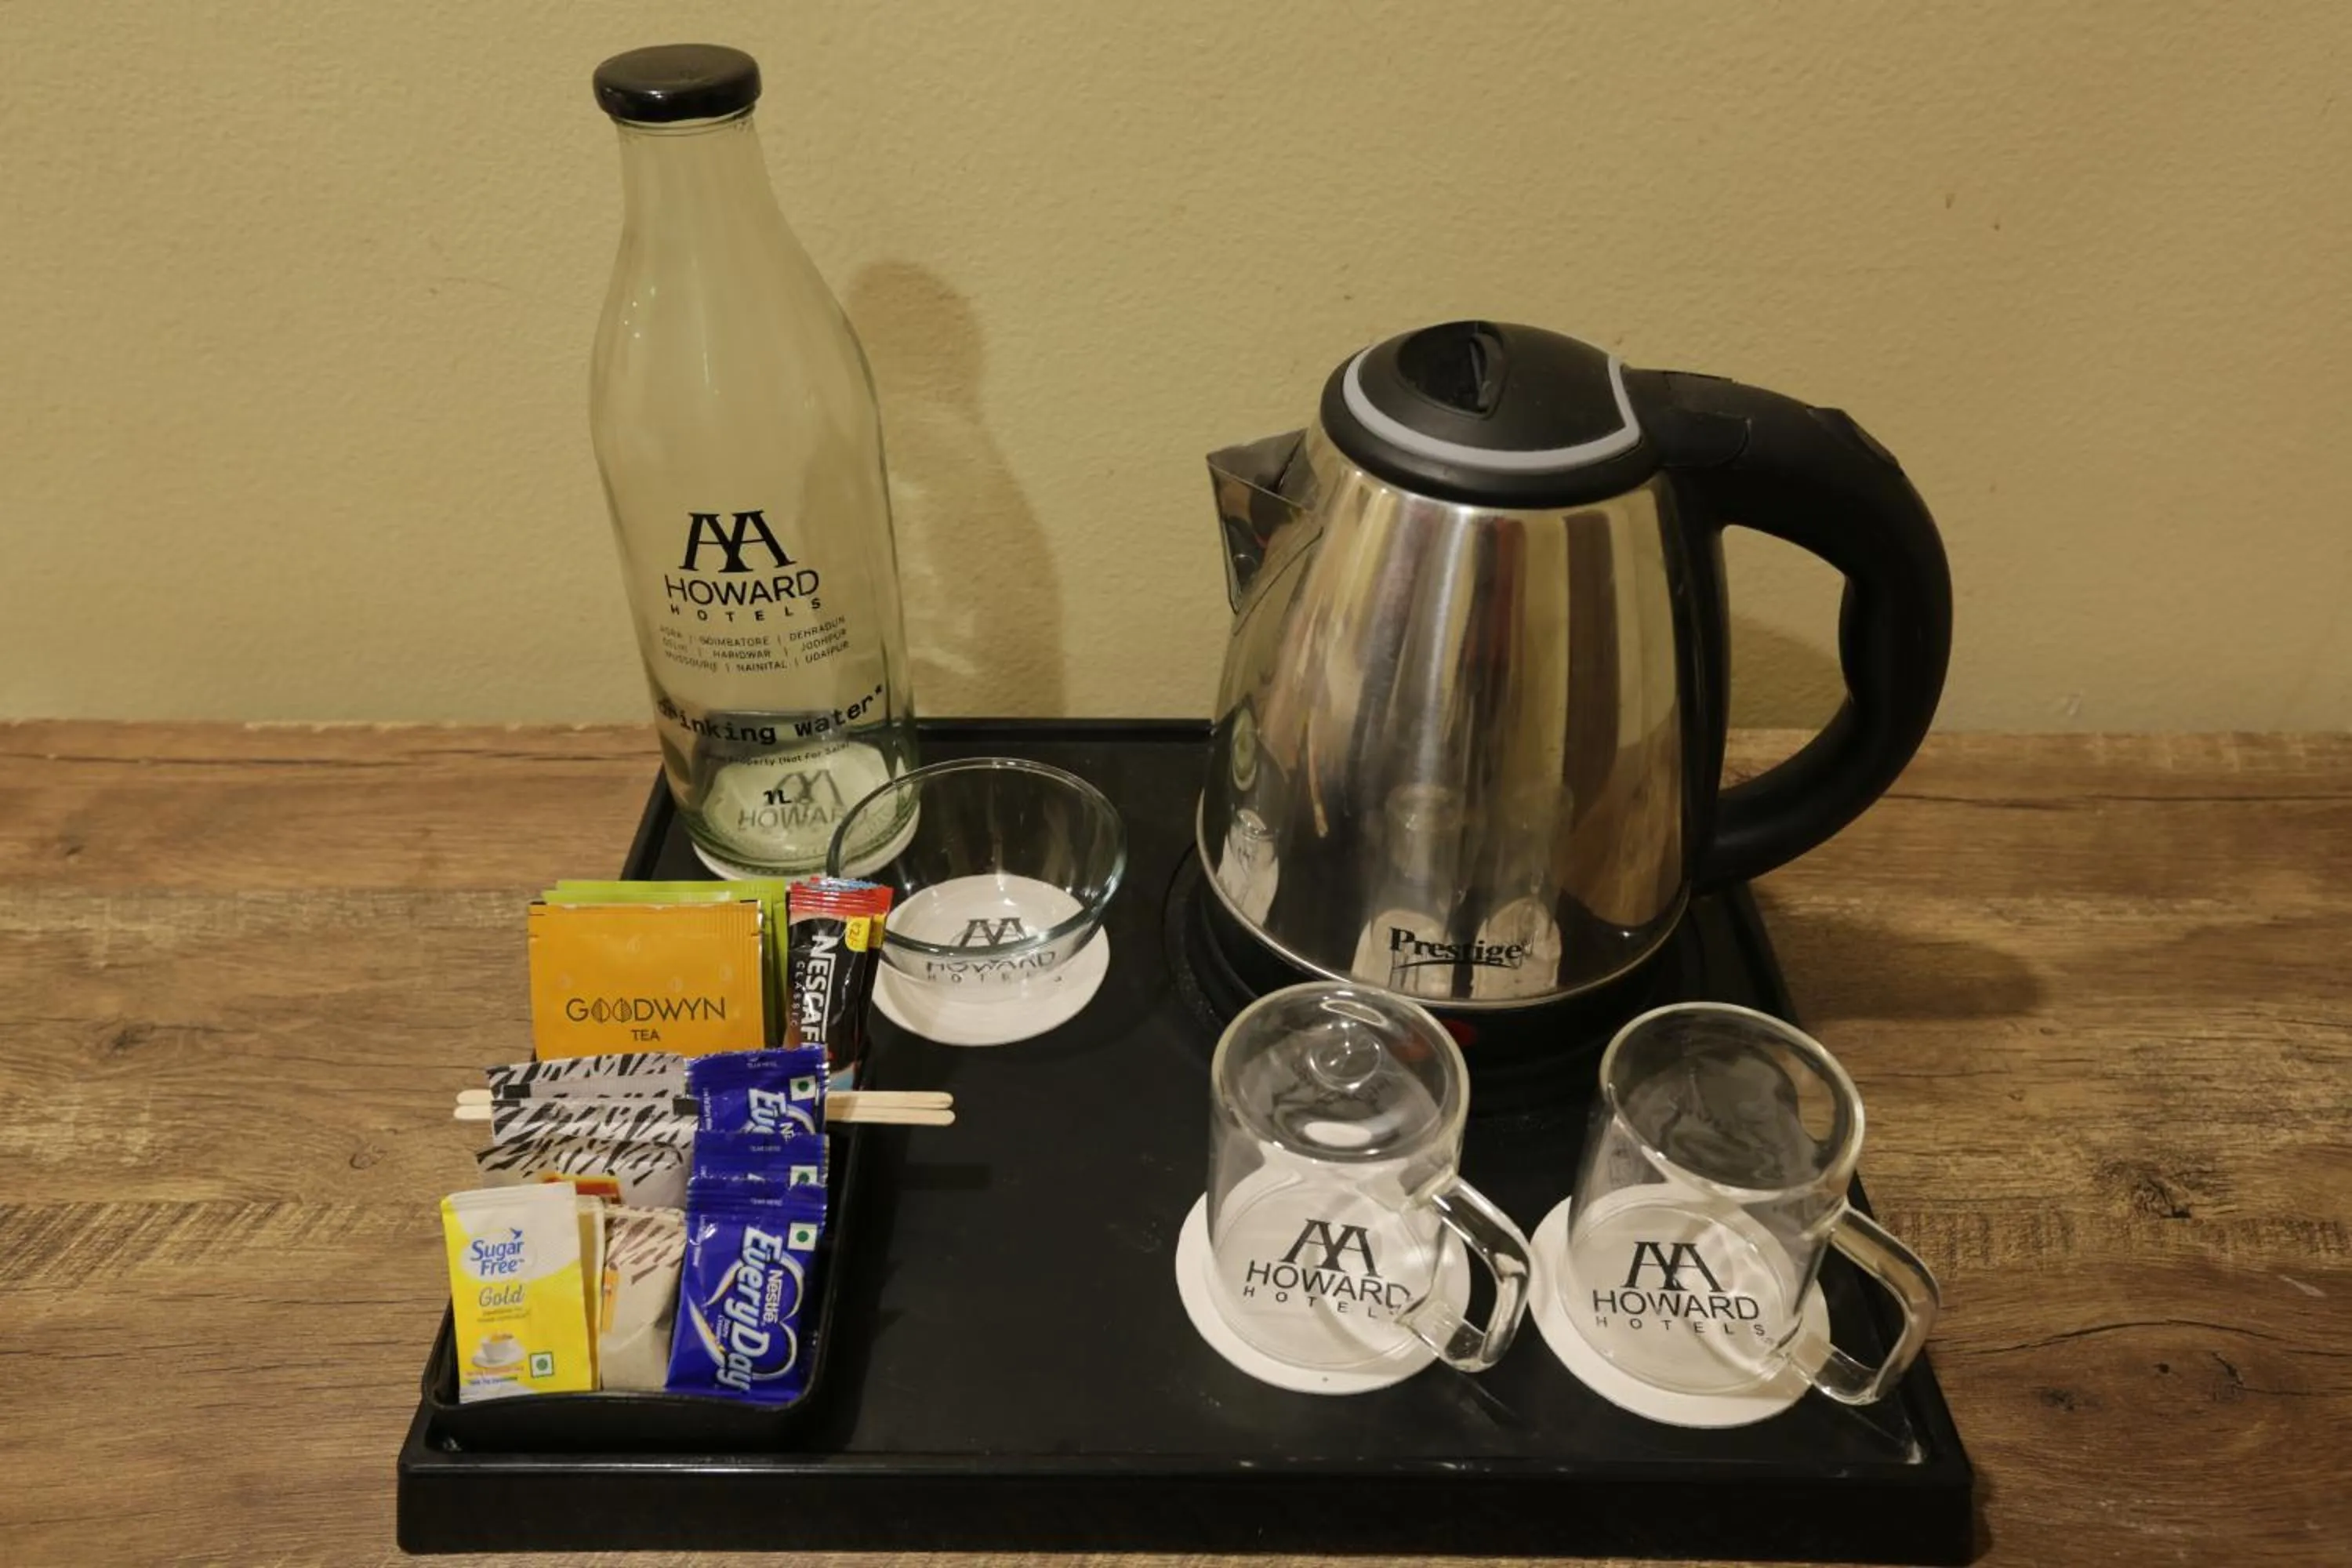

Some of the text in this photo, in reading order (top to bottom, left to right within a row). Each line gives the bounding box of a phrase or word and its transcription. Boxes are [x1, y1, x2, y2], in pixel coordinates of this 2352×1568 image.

[665, 569, 819, 606] HOWARD
[670, 597, 822, 622] HOTELS
[789, 615, 845, 641] DEHRADUN
[713, 649, 771, 659] HARIDWAR
[737, 661, 787, 672] NAINITAL
[804, 640, 849, 664] UDAIPUR
[790, 960, 807, 1028] CLASSIC
[800, 931, 840, 1048] NESCAF
[566, 996, 727, 1023] GOODWYN
[630, 1028, 661, 1042] TEA
[470, 1239, 525, 1261] Sugar
[479, 1285, 526, 1307] Gold
[1246, 1259, 1411, 1308] HOWARD
[1243, 1286, 1394, 1319] HOTEL
[1592, 1290, 1760, 1320] HOWARD
[1595, 1316, 1766, 1337] HOTELS
